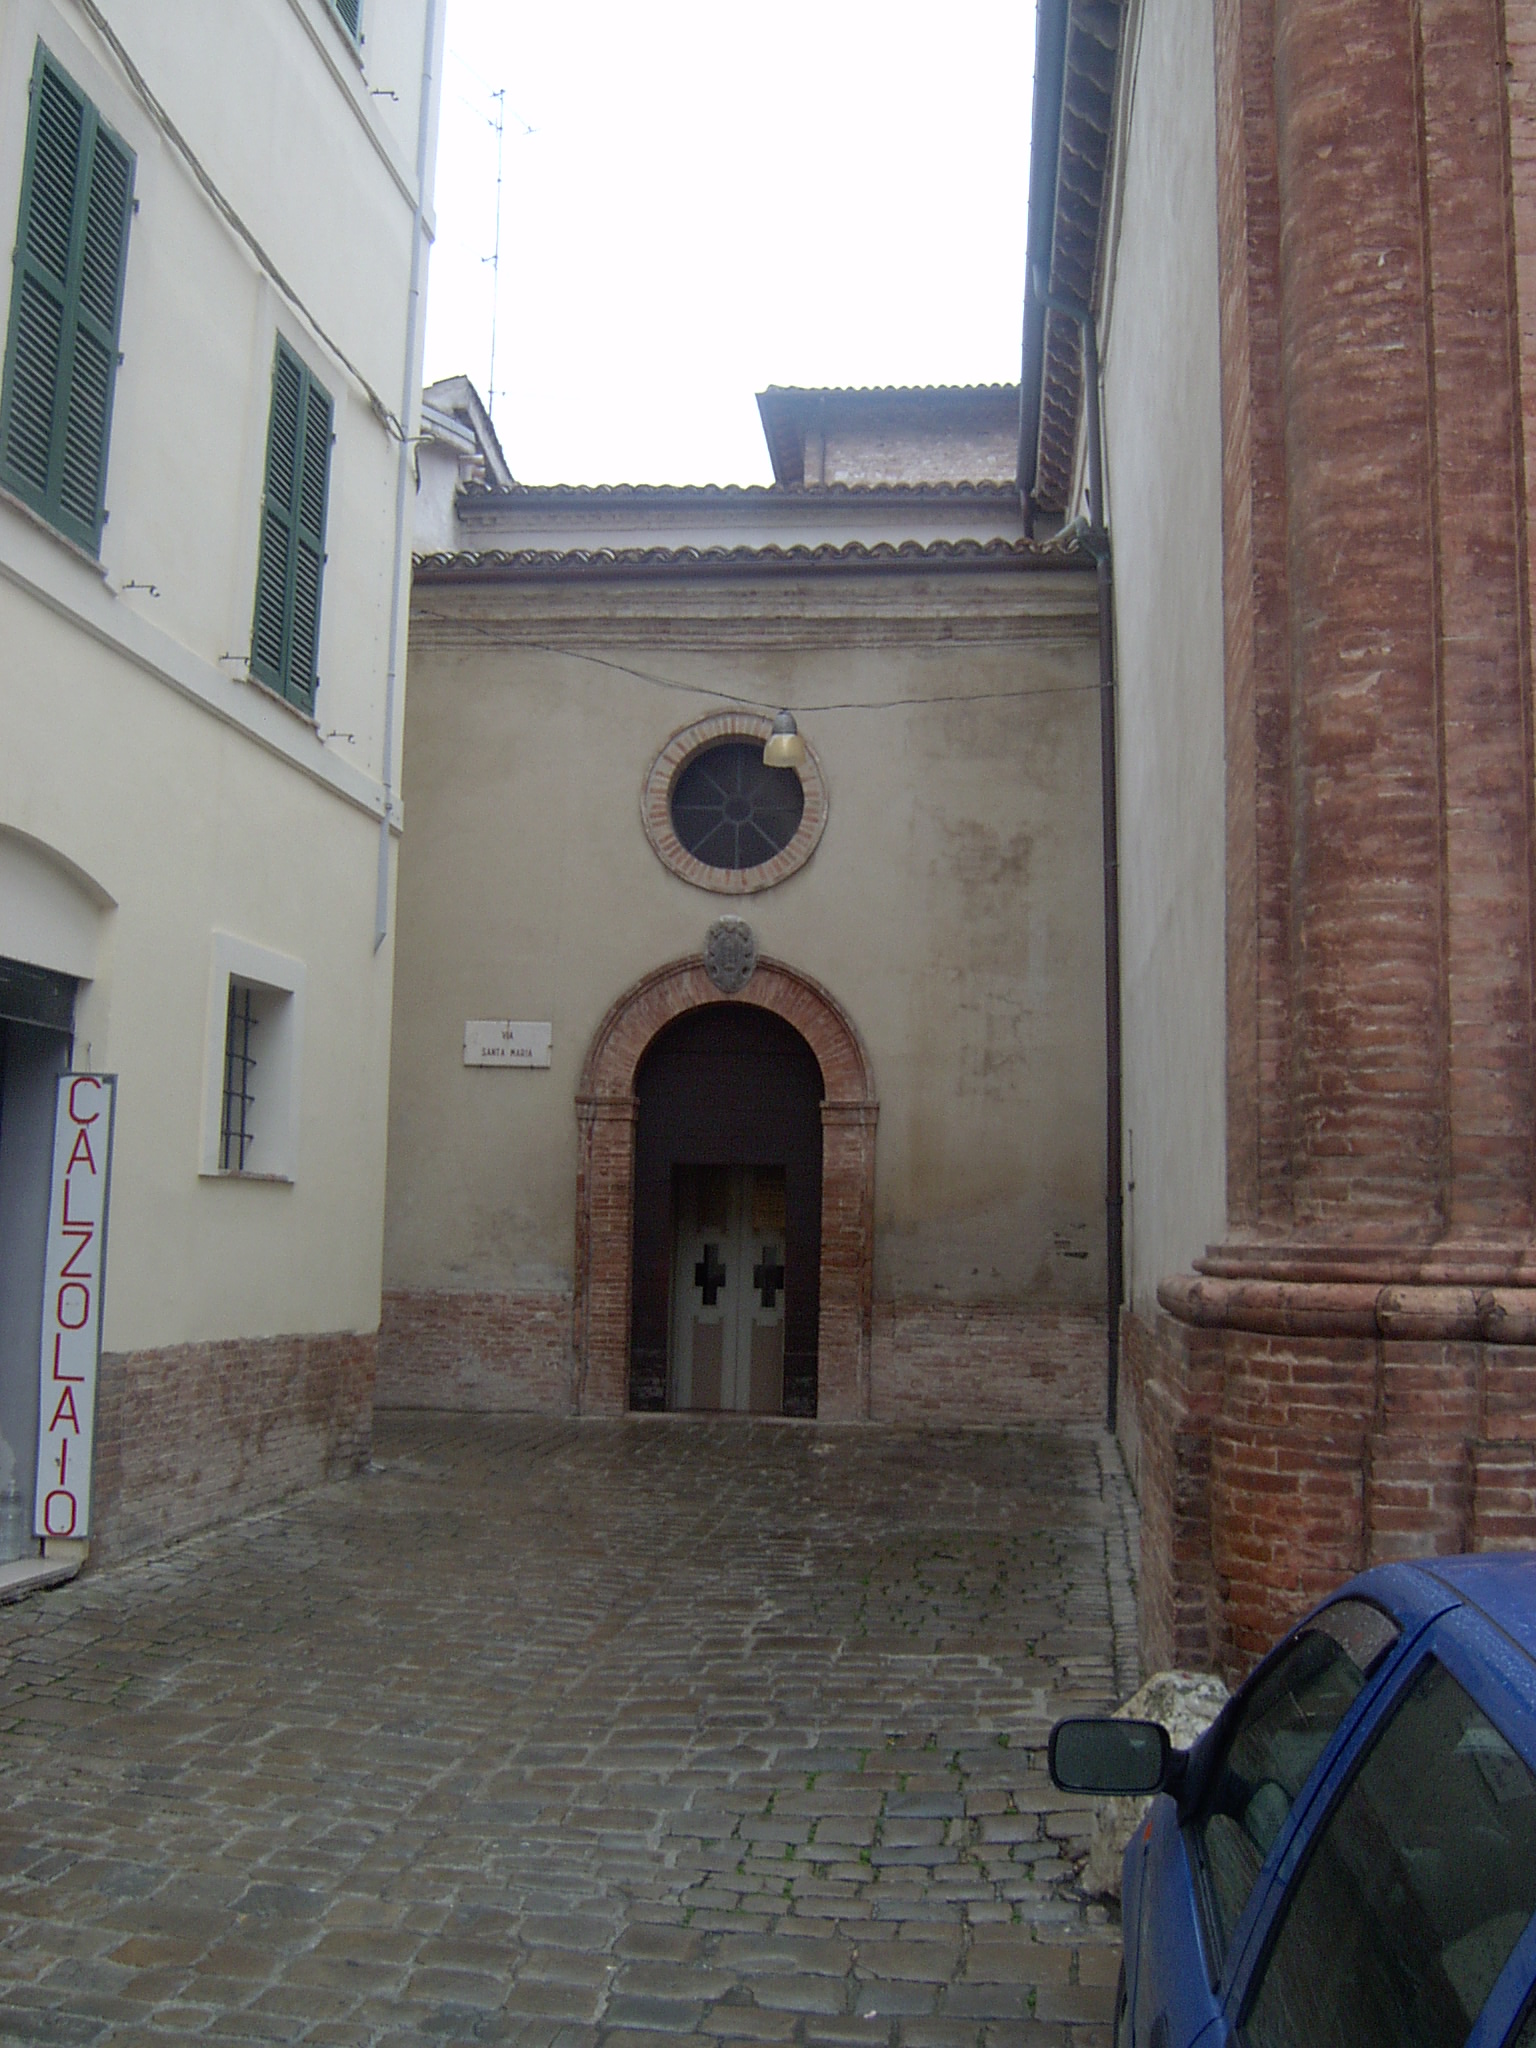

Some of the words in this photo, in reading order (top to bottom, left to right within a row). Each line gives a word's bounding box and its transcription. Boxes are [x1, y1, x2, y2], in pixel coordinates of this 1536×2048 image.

[502, 1032, 514, 1040] VIA
[481, 1048, 505, 1057] SANTA
[509, 1048, 533, 1057] MARIA
[44, 1077, 102, 1537] CALZOLAIO
